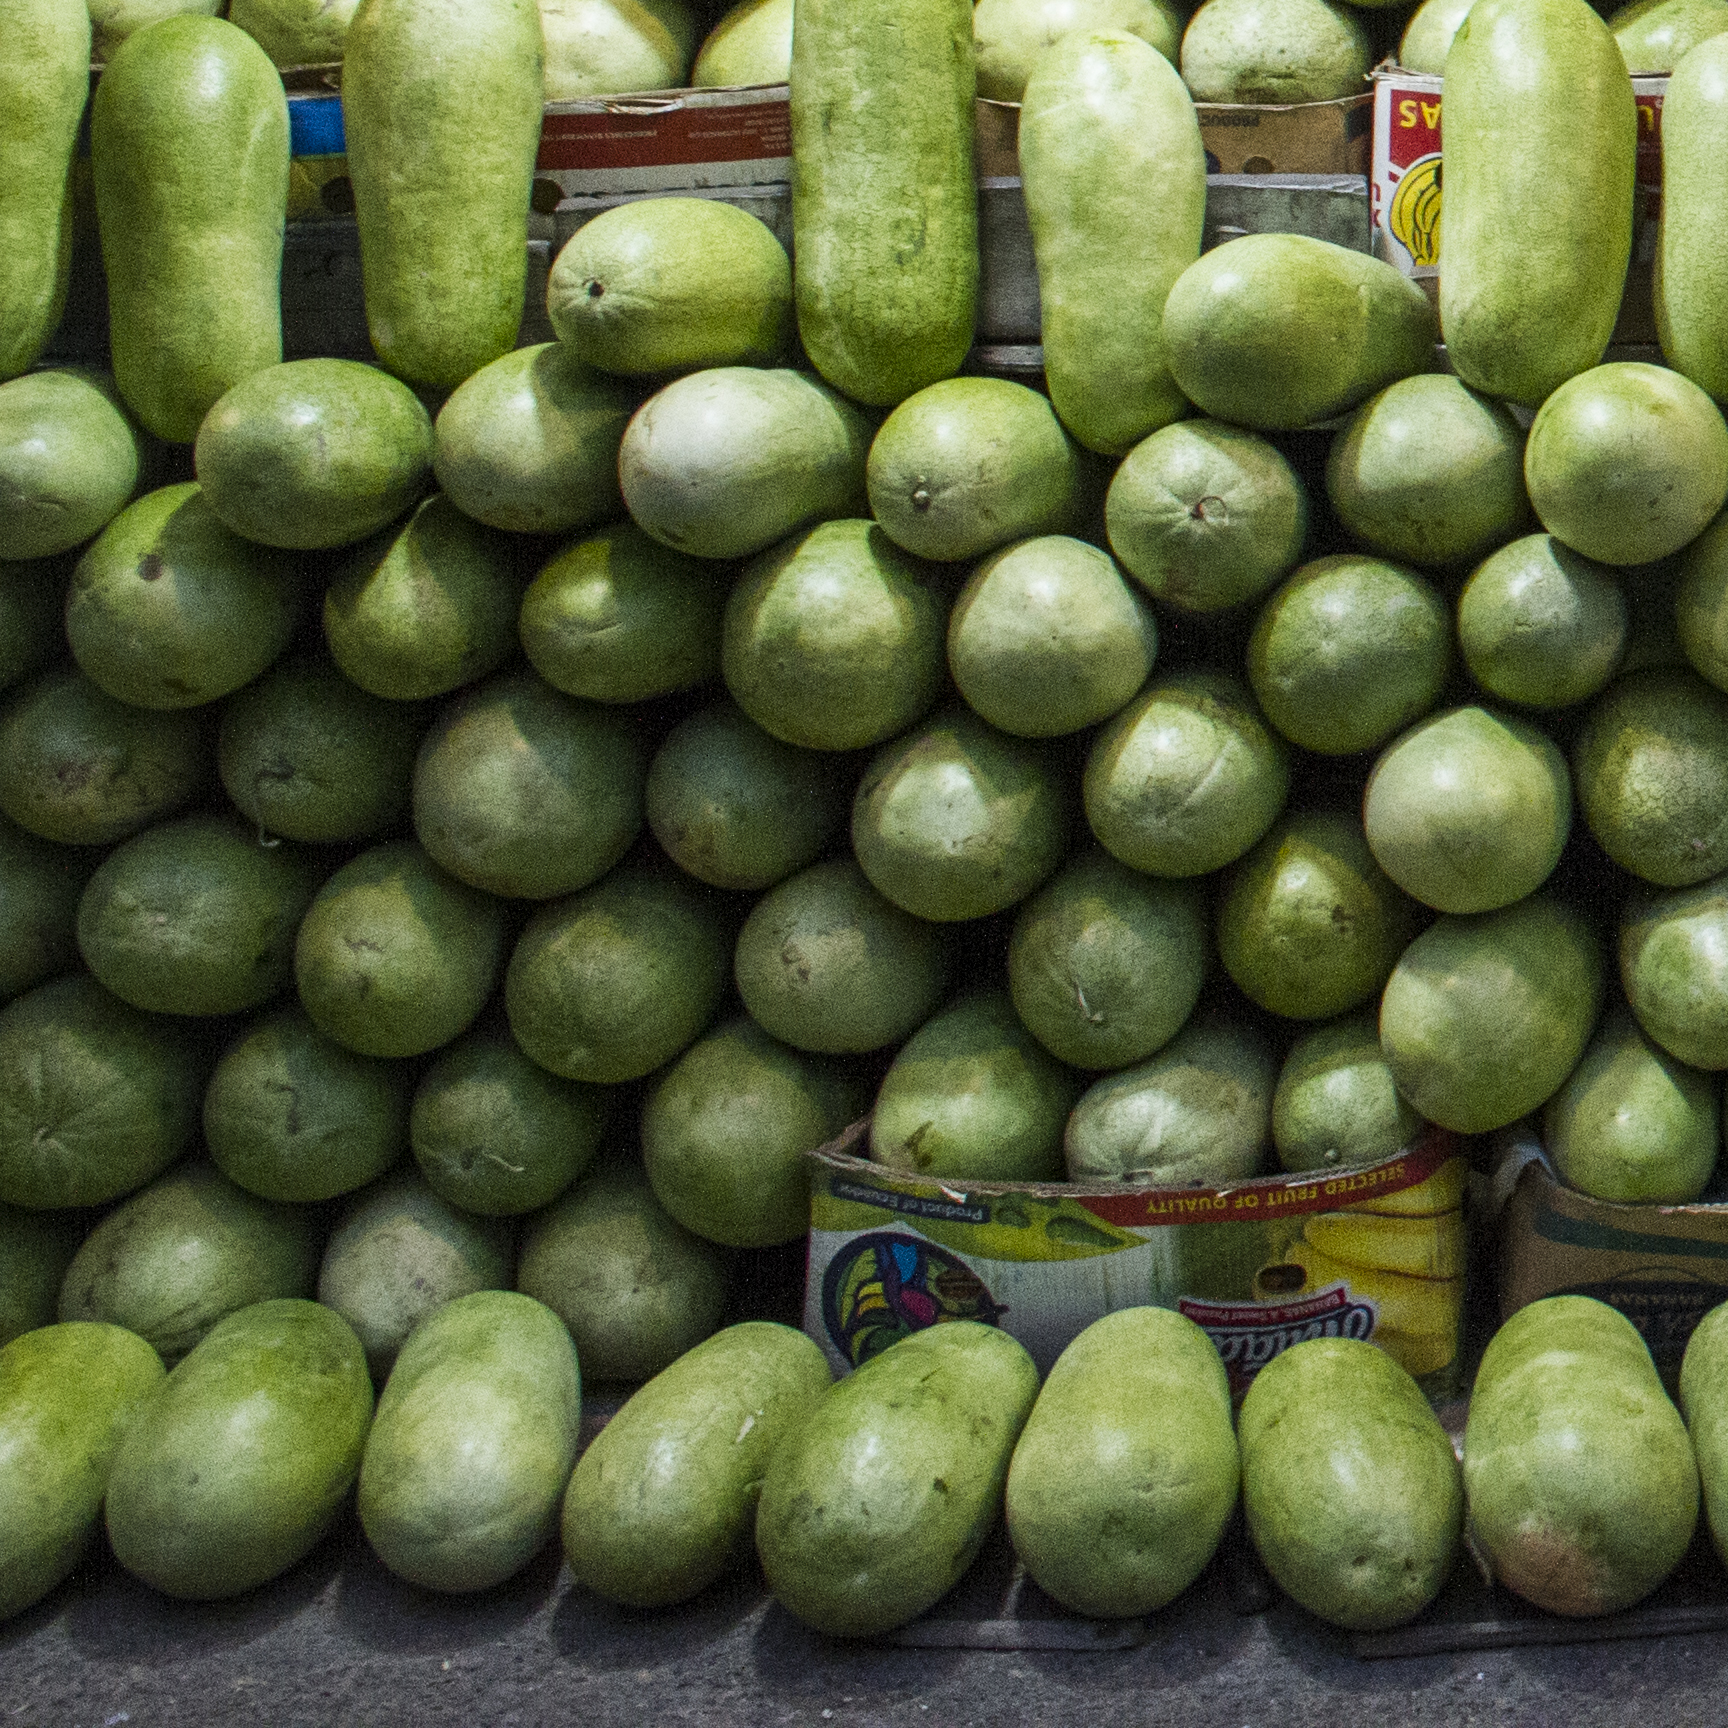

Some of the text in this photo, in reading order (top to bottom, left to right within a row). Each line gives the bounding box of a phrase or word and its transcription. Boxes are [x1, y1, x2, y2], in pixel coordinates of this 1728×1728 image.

[1145, 1161, 1406, 1215] SELECTED FRUIT OF QUALITY
[901, 1198, 919, 1212] of
[920, 1200, 984, 1221] Product
